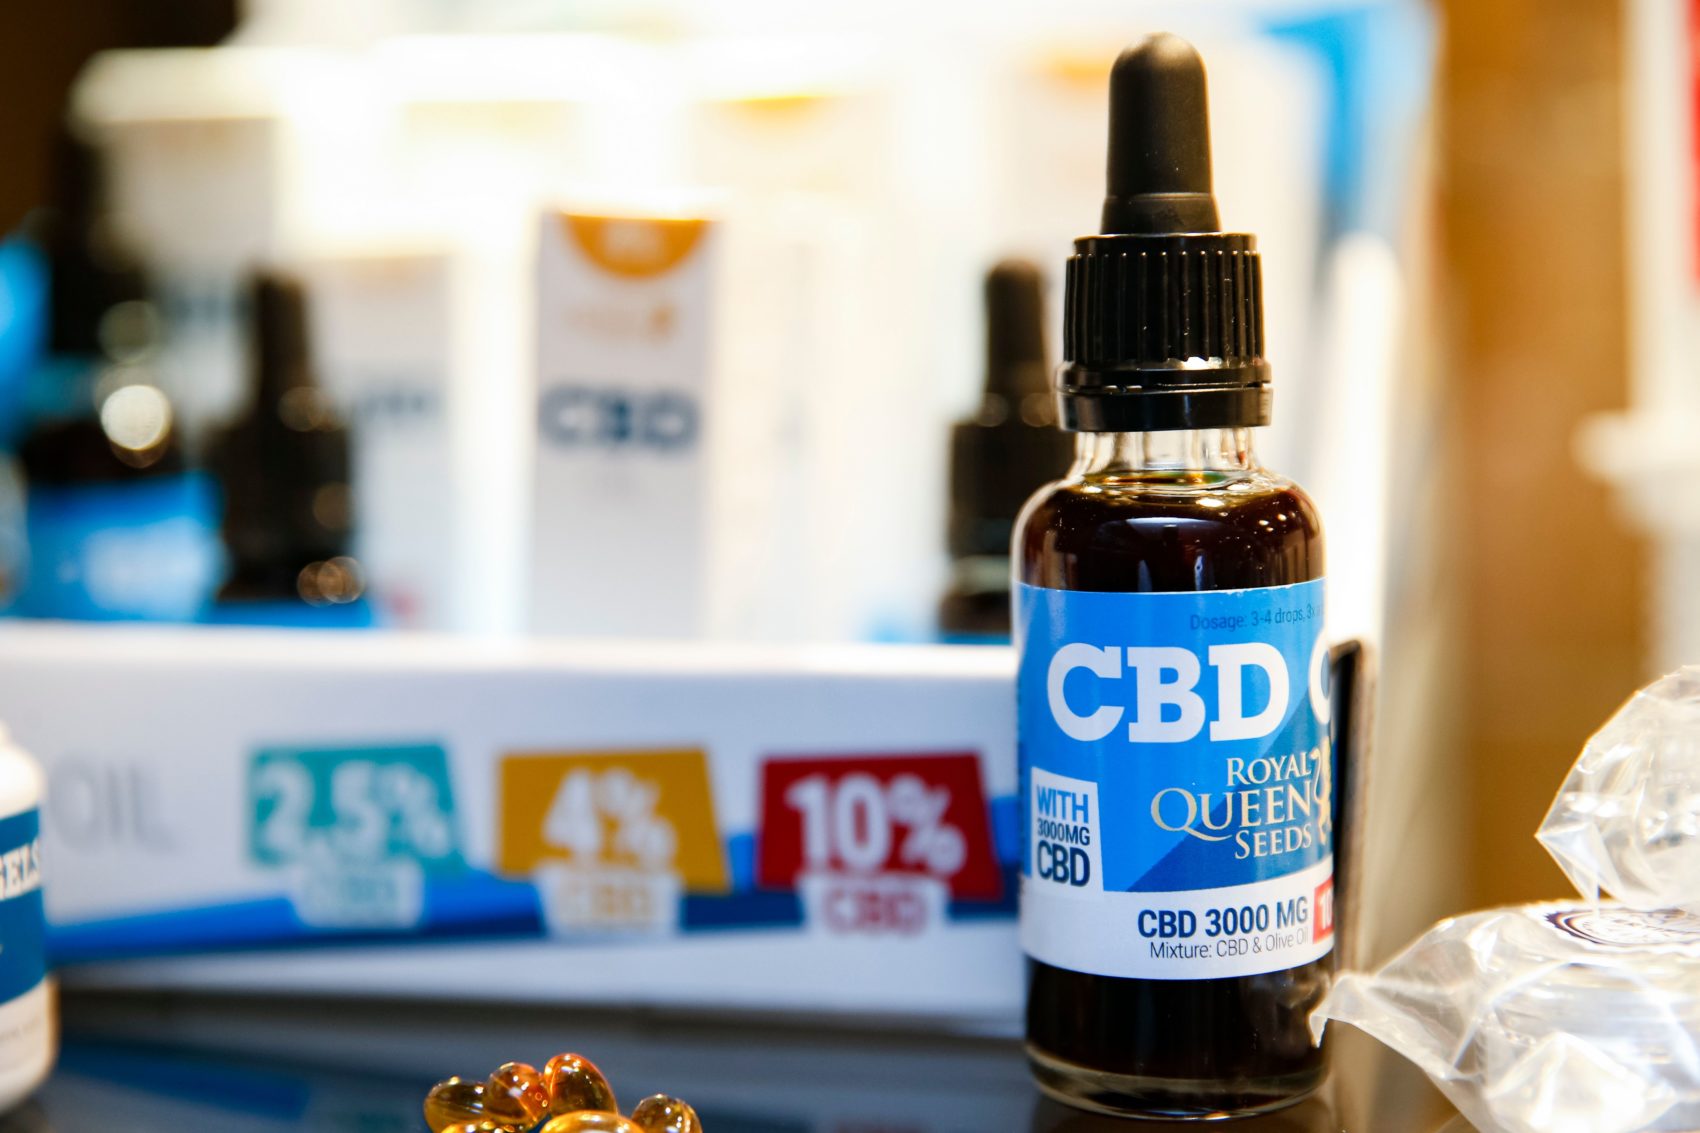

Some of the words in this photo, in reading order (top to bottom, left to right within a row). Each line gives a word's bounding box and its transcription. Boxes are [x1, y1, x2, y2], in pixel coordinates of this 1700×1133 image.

[1190, 614, 1248, 632] Dosage:
[1250, 610, 1271, 626] 3-4
[1047, 642, 1289, 743] CBD
[1227, 753, 1312, 786] ROYAL
[542, 767, 678, 868] 4%
[785, 773, 967, 873] 10%
[1037, 785, 1088, 823] WITH
[1151, 780, 1312, 842] QUEEN
[1037, 818, 1090, 846] 3000MG
[1235, 823, 1312, 860] SEEDS
[1038, 840, 1090, 887] CBD
[1138, 909, 1197, 938] CBD
[1205, 904, 1270, 937] 3000
[1277, 896, 1308, 929] MG
[1150, 941, 1212, 959] Mixture:
[1216, 938, 1249, 957] CBD
[1252, 936, 1262, 953] &
[1265, 931, 1294, 951] Olive
